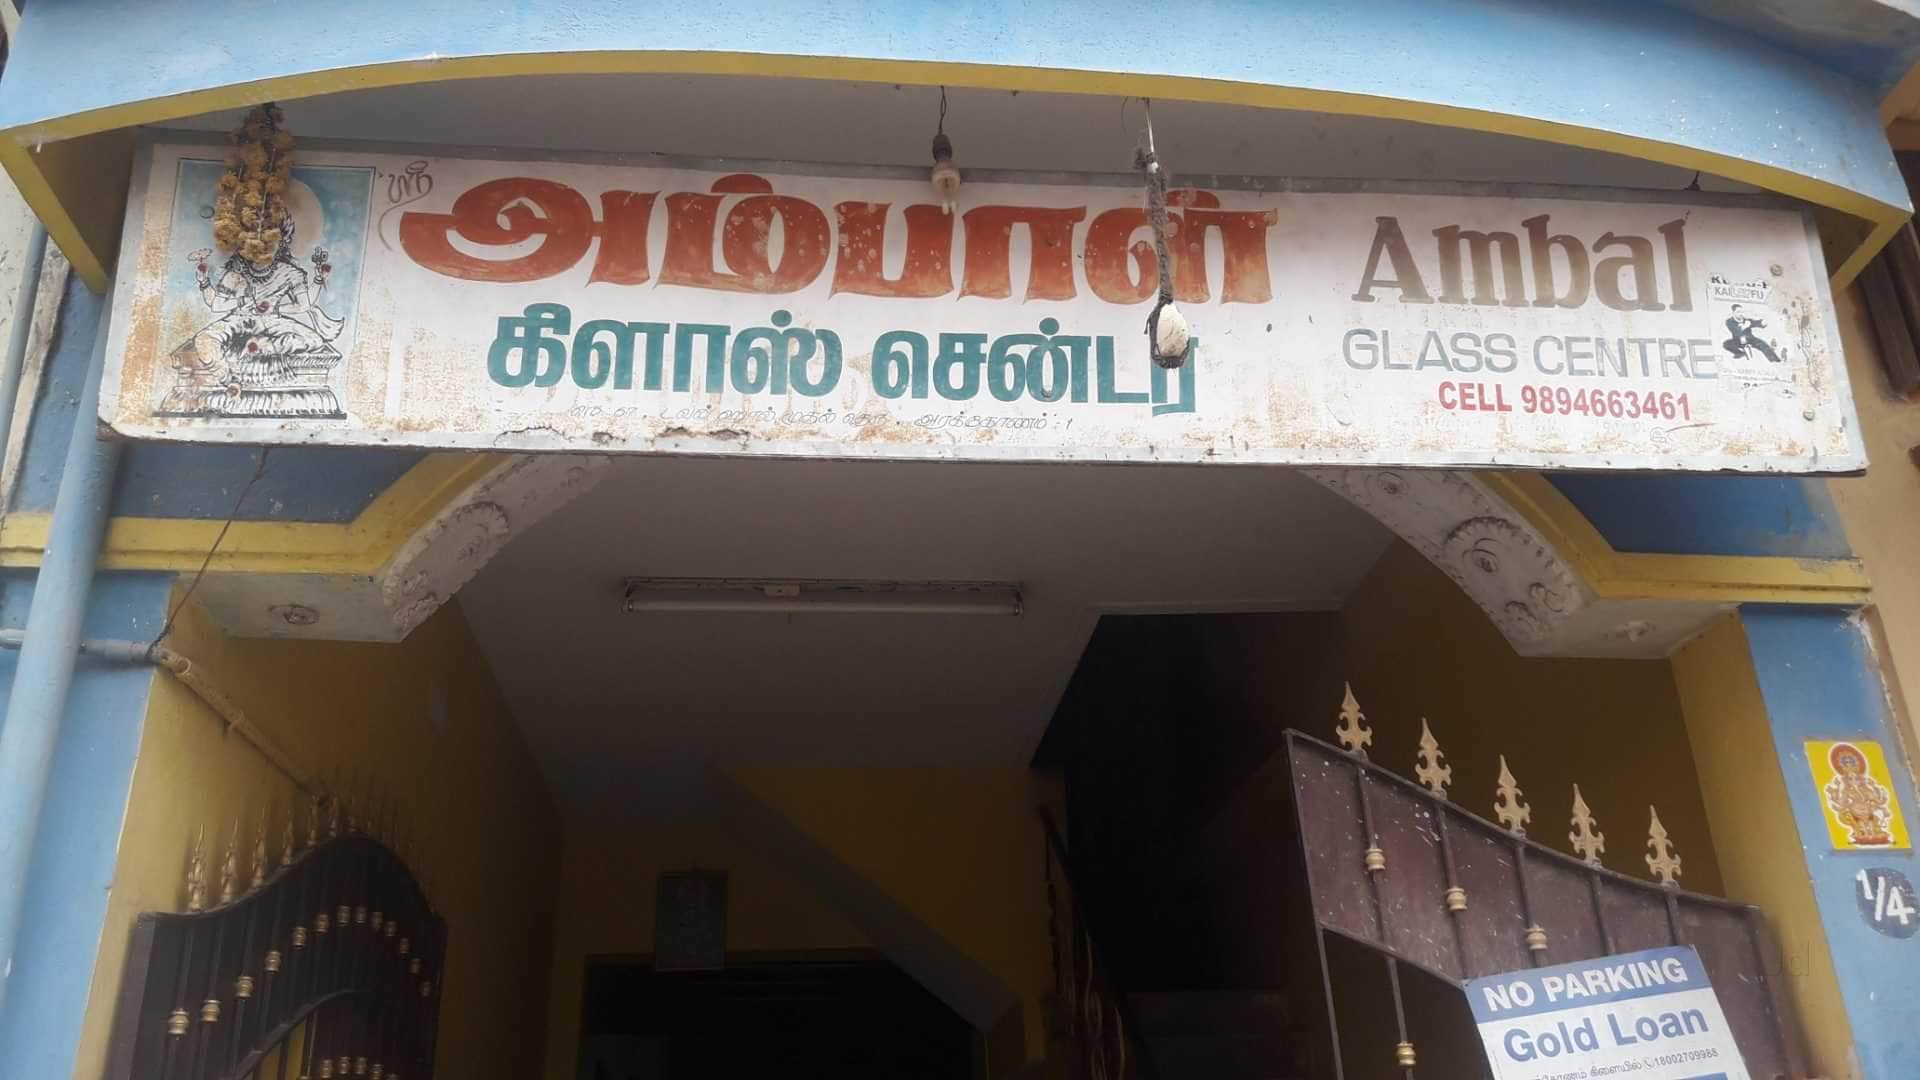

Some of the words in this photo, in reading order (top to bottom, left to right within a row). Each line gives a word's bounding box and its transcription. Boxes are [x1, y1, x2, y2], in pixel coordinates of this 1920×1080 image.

[400, 173, 1278, 305] அம்பாள்
[1351, 214, 1694, 312] Ambal
[1342, 327, 1517, 373] GLASS
[1533, 335, 1719, 380] CENTRE
[1438, 381, 1513, 412] CELL
[1521, 383, 1691, 421] 9894663461
[1855, 868, 1916, 925] 1/4
[1483, 981, 1535, 1012] NO
[1541, 957, 1689, 1002] PARKING
[1503, 1017, 1600, 1063] Gold
[1606, 1007, 1709, 1047] Loan
